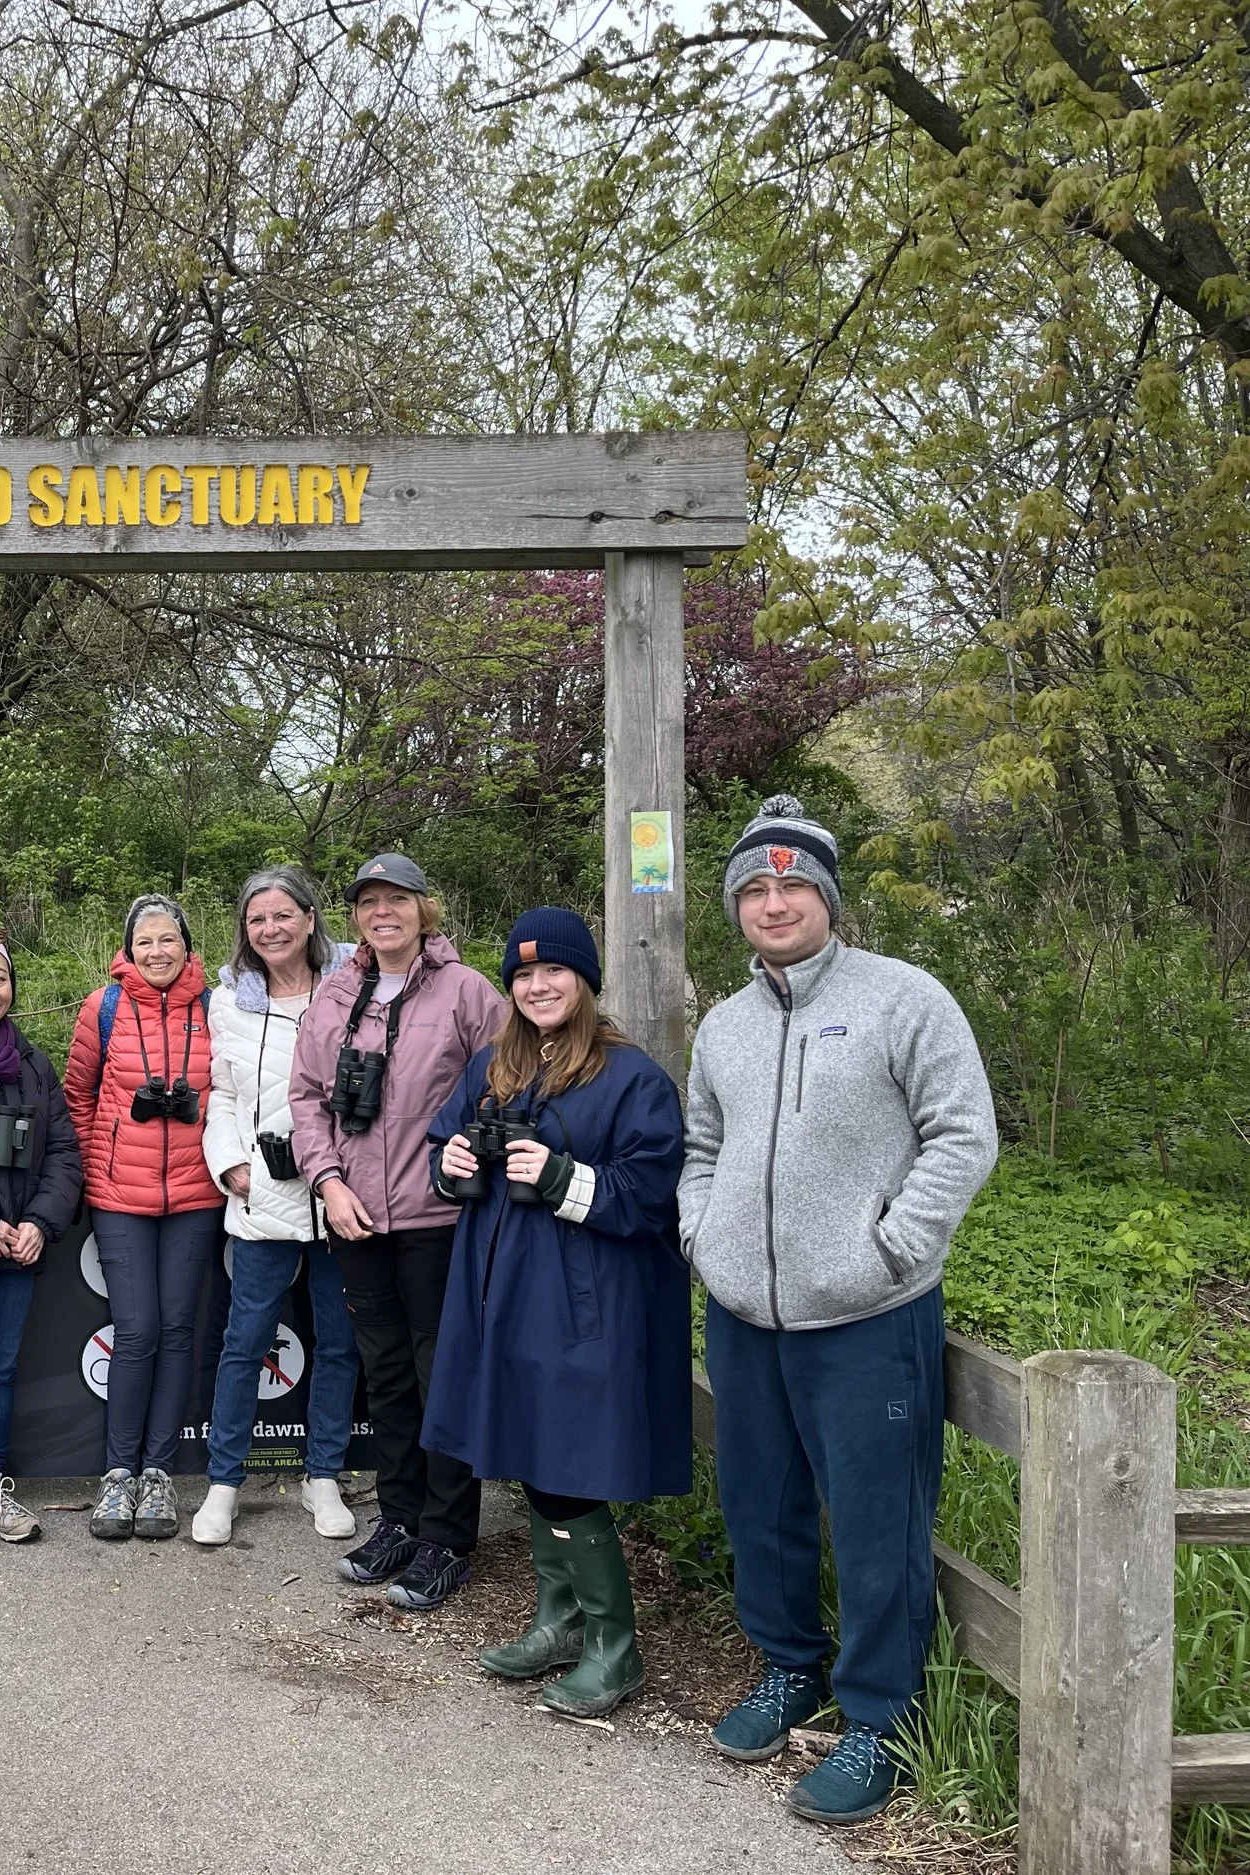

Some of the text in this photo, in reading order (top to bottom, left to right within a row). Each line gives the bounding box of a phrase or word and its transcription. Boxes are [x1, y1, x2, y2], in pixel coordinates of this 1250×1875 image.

[28, 464, 370, 526] SANCTUARY
[253, 1420, 306, 1438] dawn
[243, 1458, 304, 1467] TURAL AREAS
